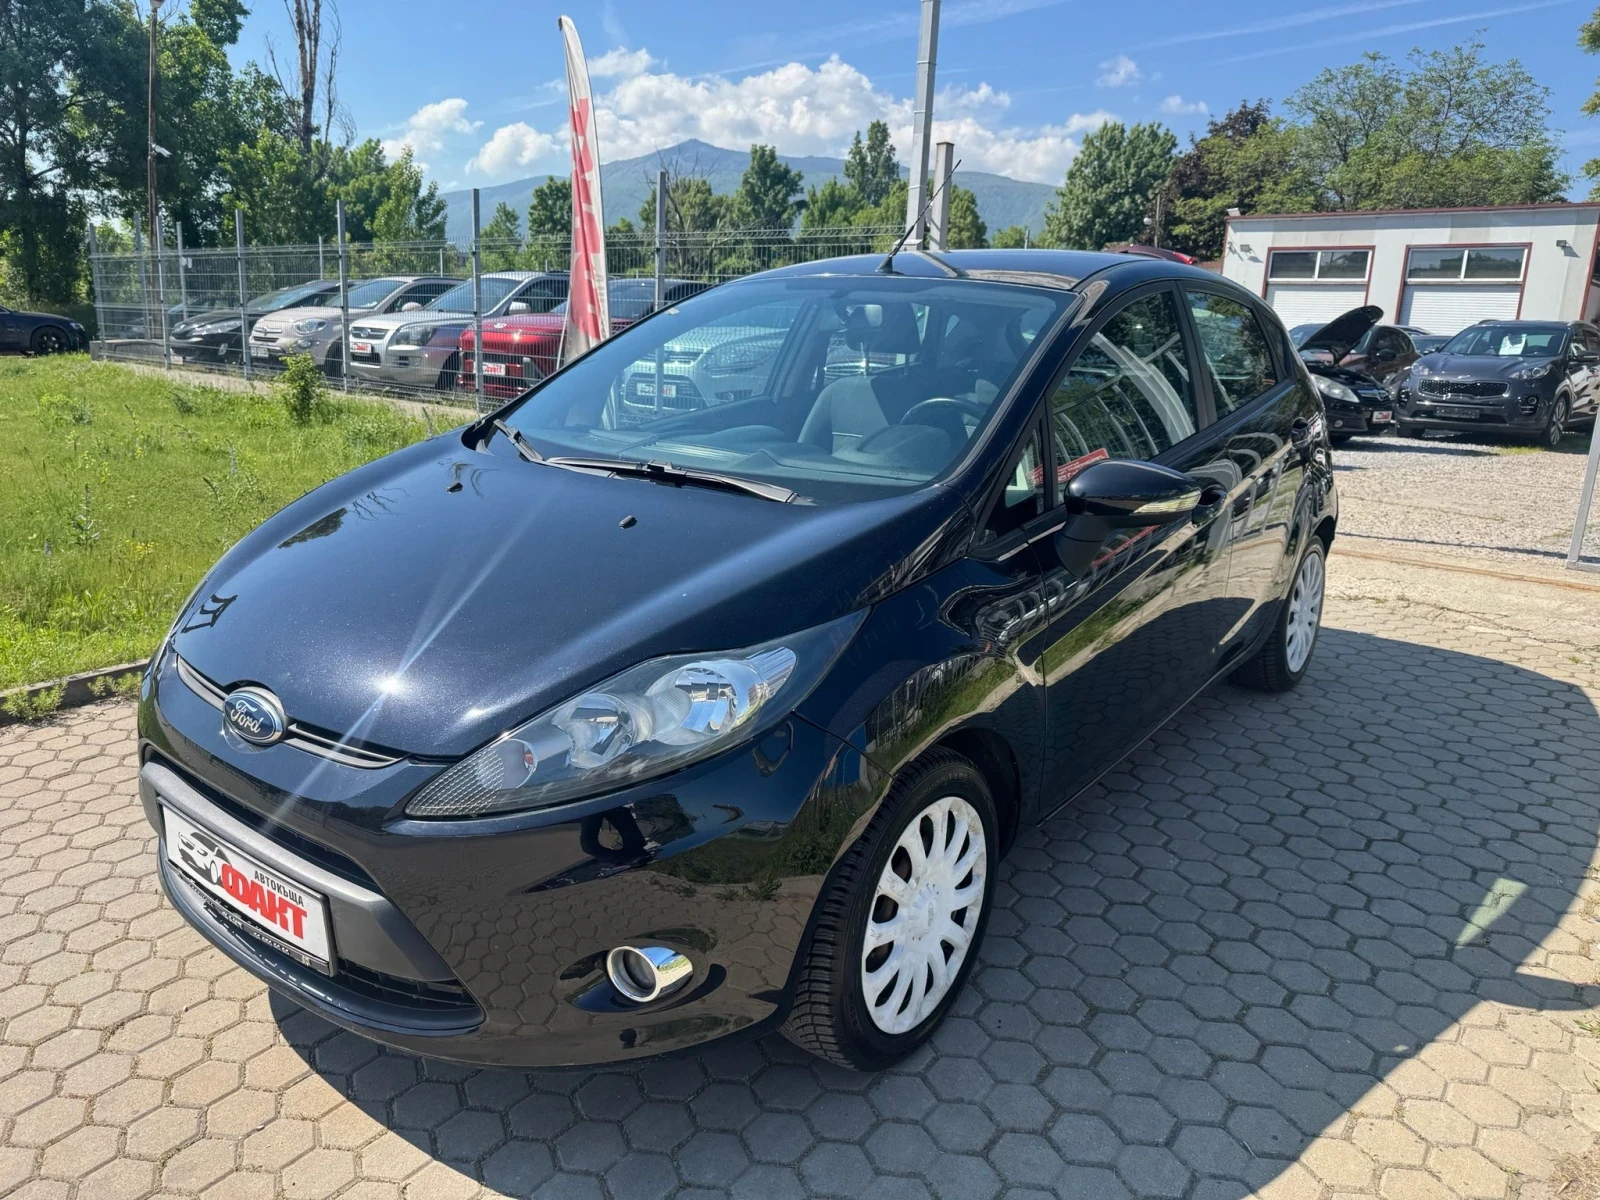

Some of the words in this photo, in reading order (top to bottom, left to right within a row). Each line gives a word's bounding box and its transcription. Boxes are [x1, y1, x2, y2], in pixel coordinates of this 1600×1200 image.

[231, 700, 264, 733] Ford
[221, 863, 307, 940] ФАКТ
[254, 870, 304, 907] АВТОКЪЩА
